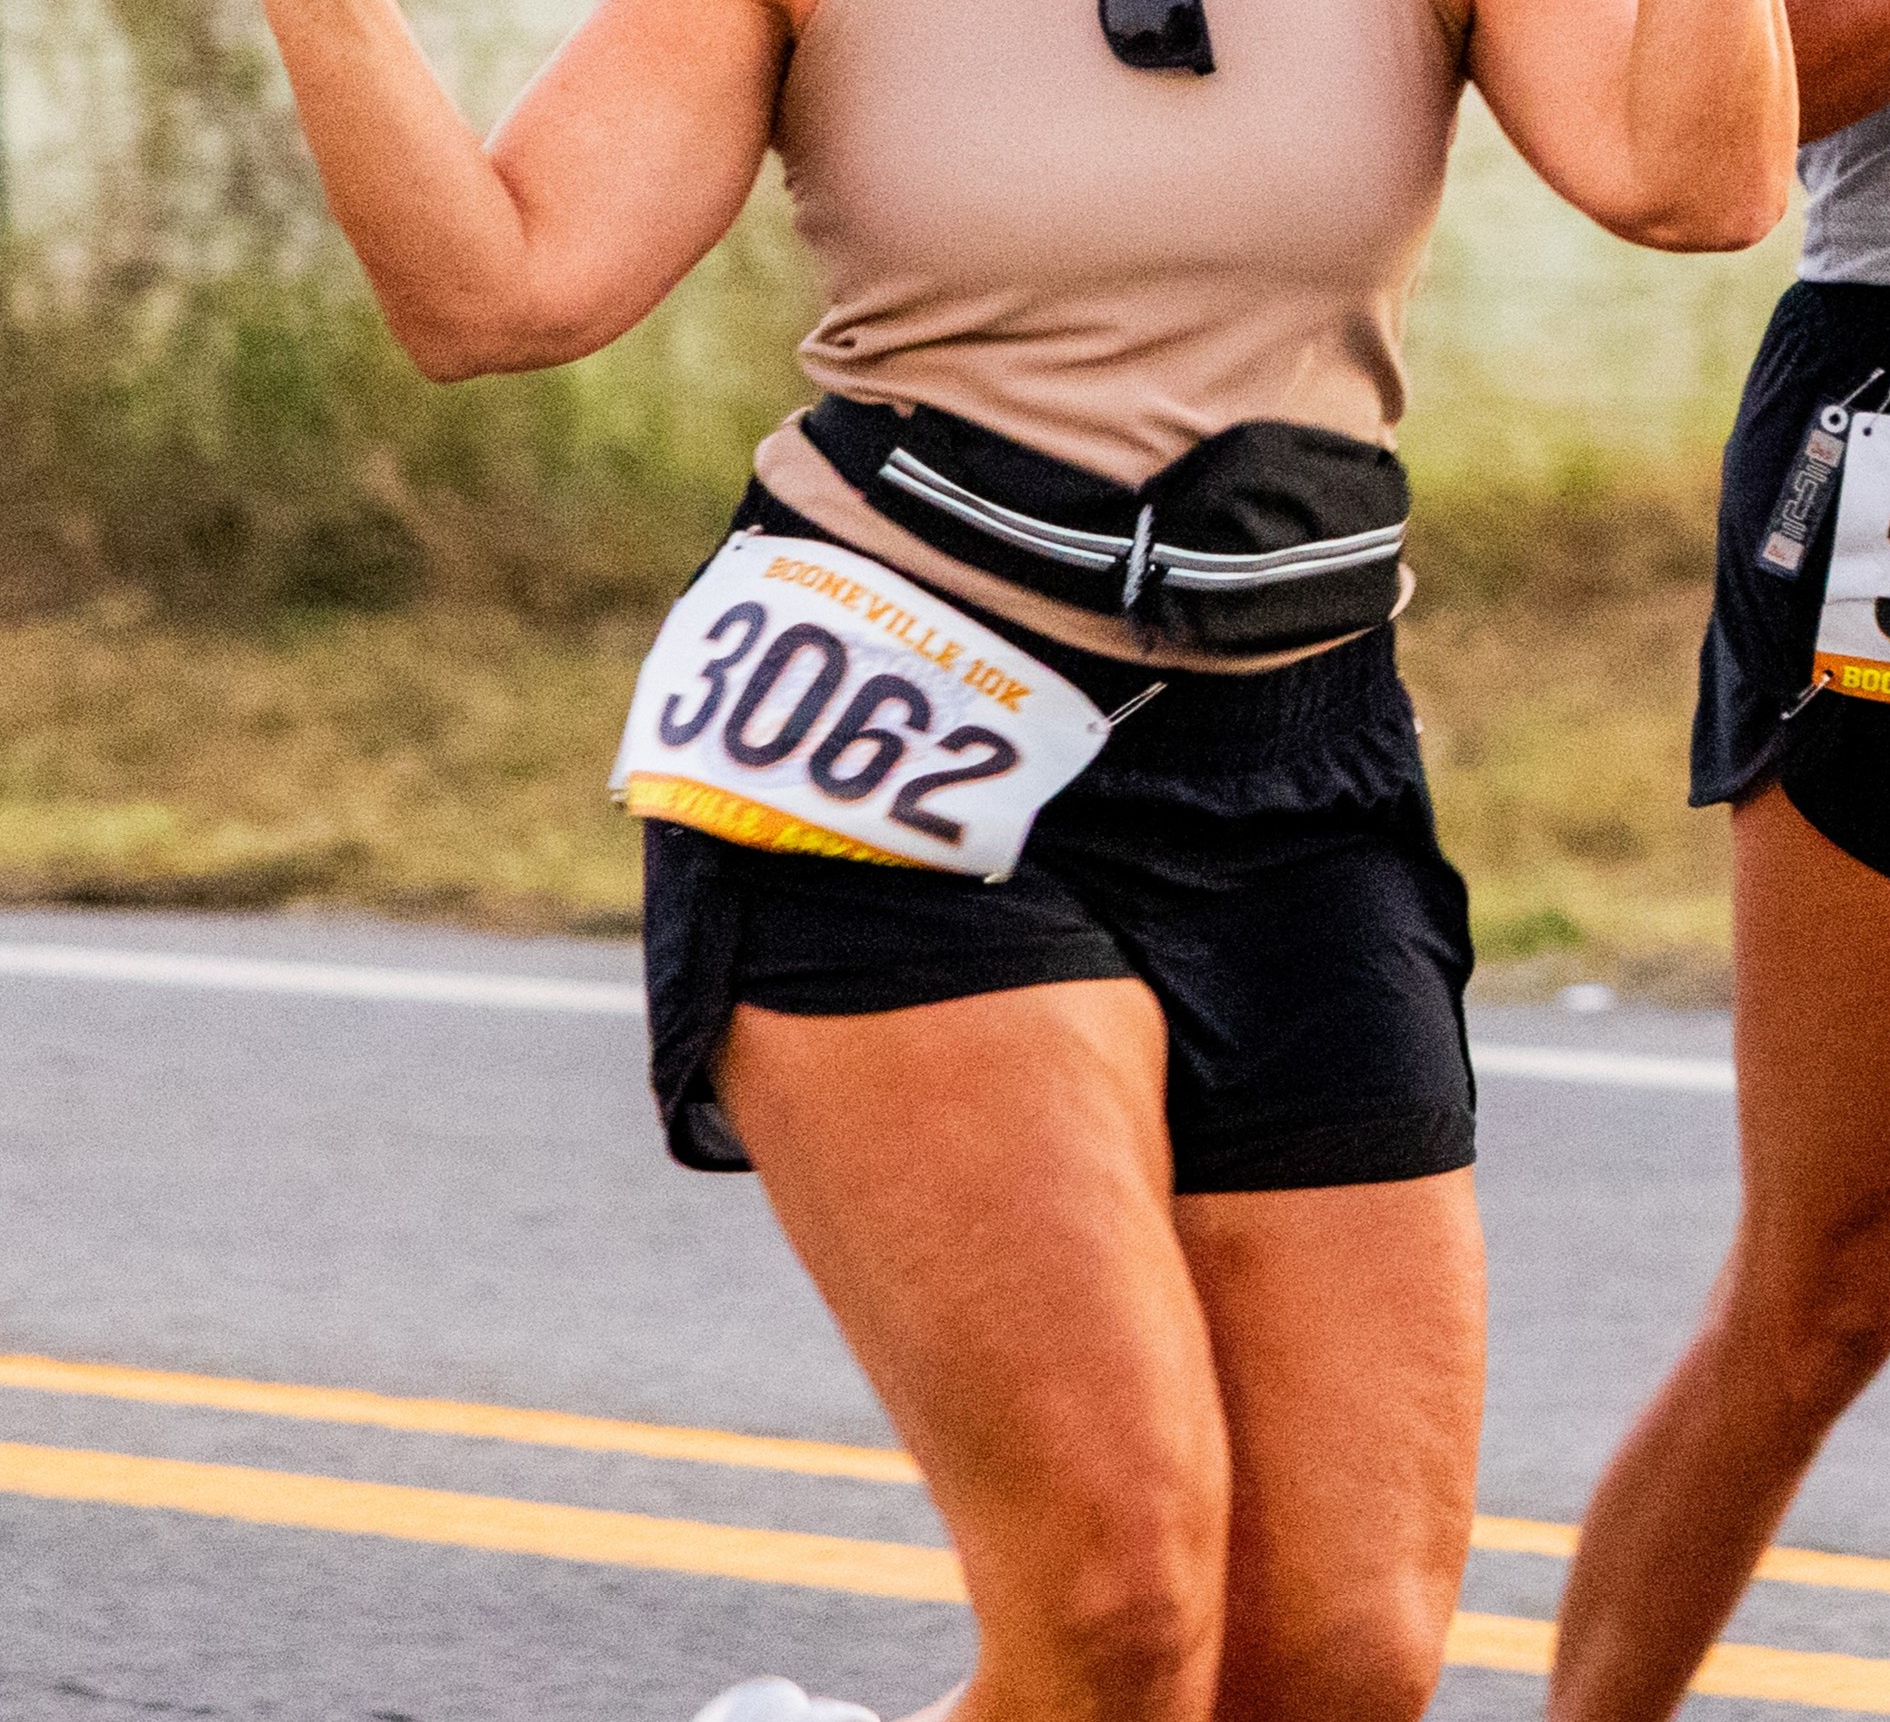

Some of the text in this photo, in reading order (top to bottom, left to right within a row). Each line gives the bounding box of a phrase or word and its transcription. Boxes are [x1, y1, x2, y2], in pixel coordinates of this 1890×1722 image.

[656, 600, 1021, 846] 3062
[765, 556, 1032, 713] BOONEVILLE 10K
